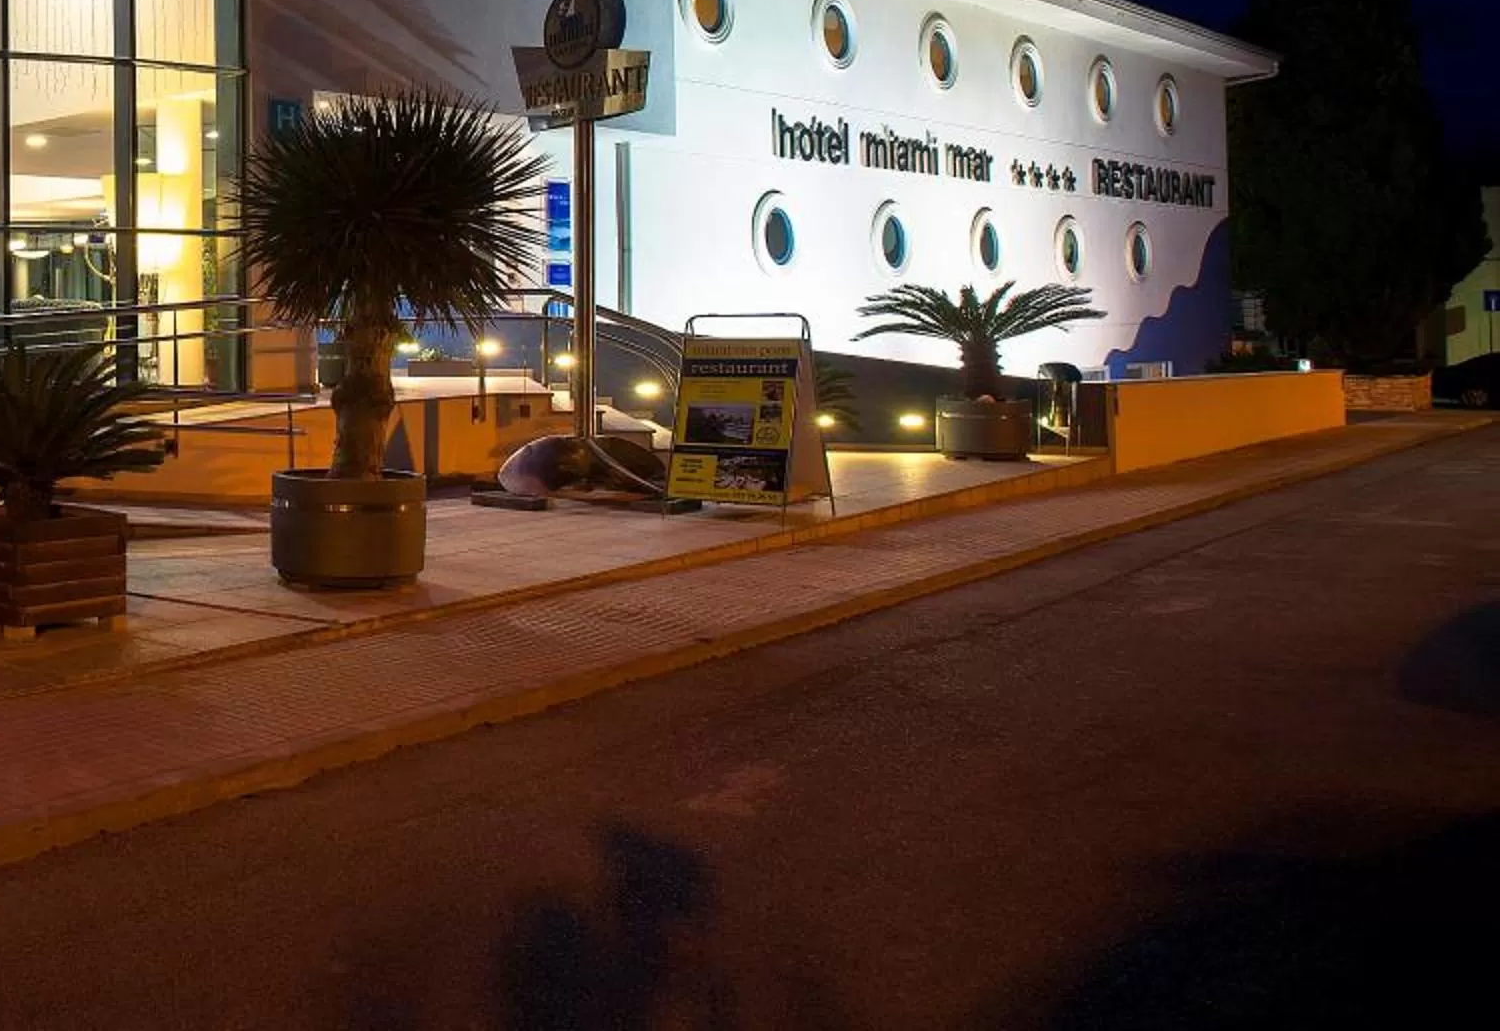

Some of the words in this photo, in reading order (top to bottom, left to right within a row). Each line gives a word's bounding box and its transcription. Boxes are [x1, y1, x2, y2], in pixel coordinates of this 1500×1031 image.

[771, 107, 849, 165] hotel
[859, 125, 939, 176] miami
[944, 142, 994, 183] mar
[1091, 158, 1216, 208] RESTAURANT
[691, 362, 789, 375] restaurant
